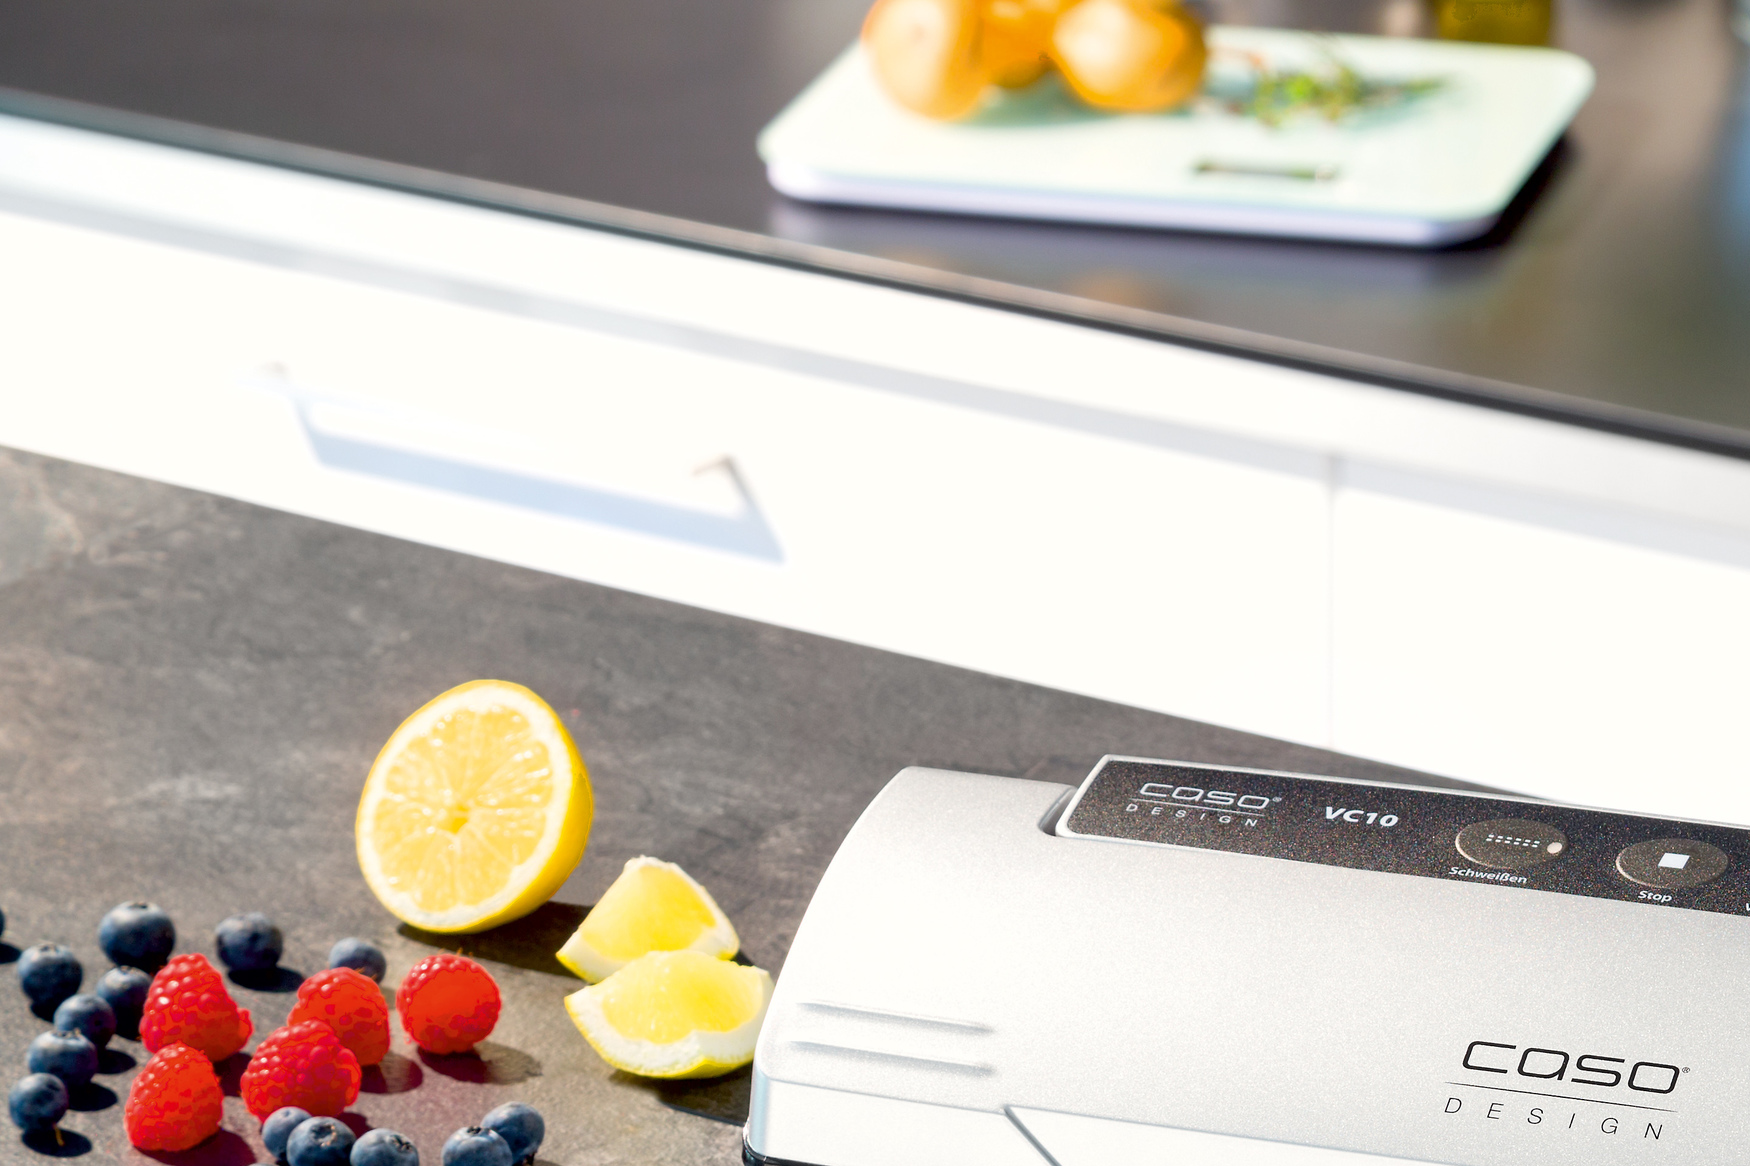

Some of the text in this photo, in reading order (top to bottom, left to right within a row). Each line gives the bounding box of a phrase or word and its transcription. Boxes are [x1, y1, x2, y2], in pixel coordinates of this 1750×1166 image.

[1125, 803, 1258, 828] DESIGN
[1324, 806, 1399, 828] VC10
[1449, 866, 1527, 885] Schweißen
[1638, 889, 1672, 904] Stop
[1444, 1097, 1663, 1140] DESIGN
